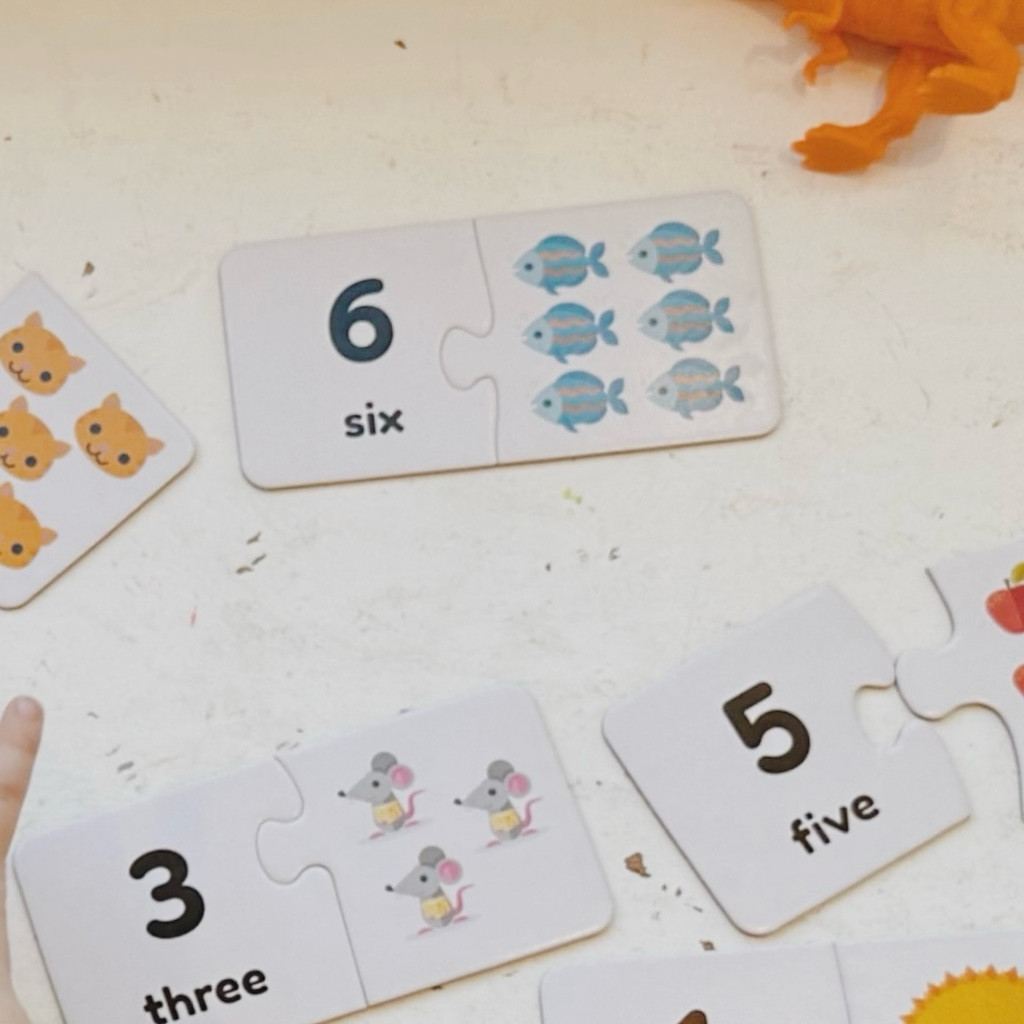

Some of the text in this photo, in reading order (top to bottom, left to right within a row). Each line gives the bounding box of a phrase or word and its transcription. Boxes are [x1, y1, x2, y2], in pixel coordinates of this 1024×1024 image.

[329, 278, 394, 363] 6
[344, 402, 405, 438] six
[723, 682, 811, 774] 5
[791, 795, 880, 854] five
[129, 849, 205, 939] 3
